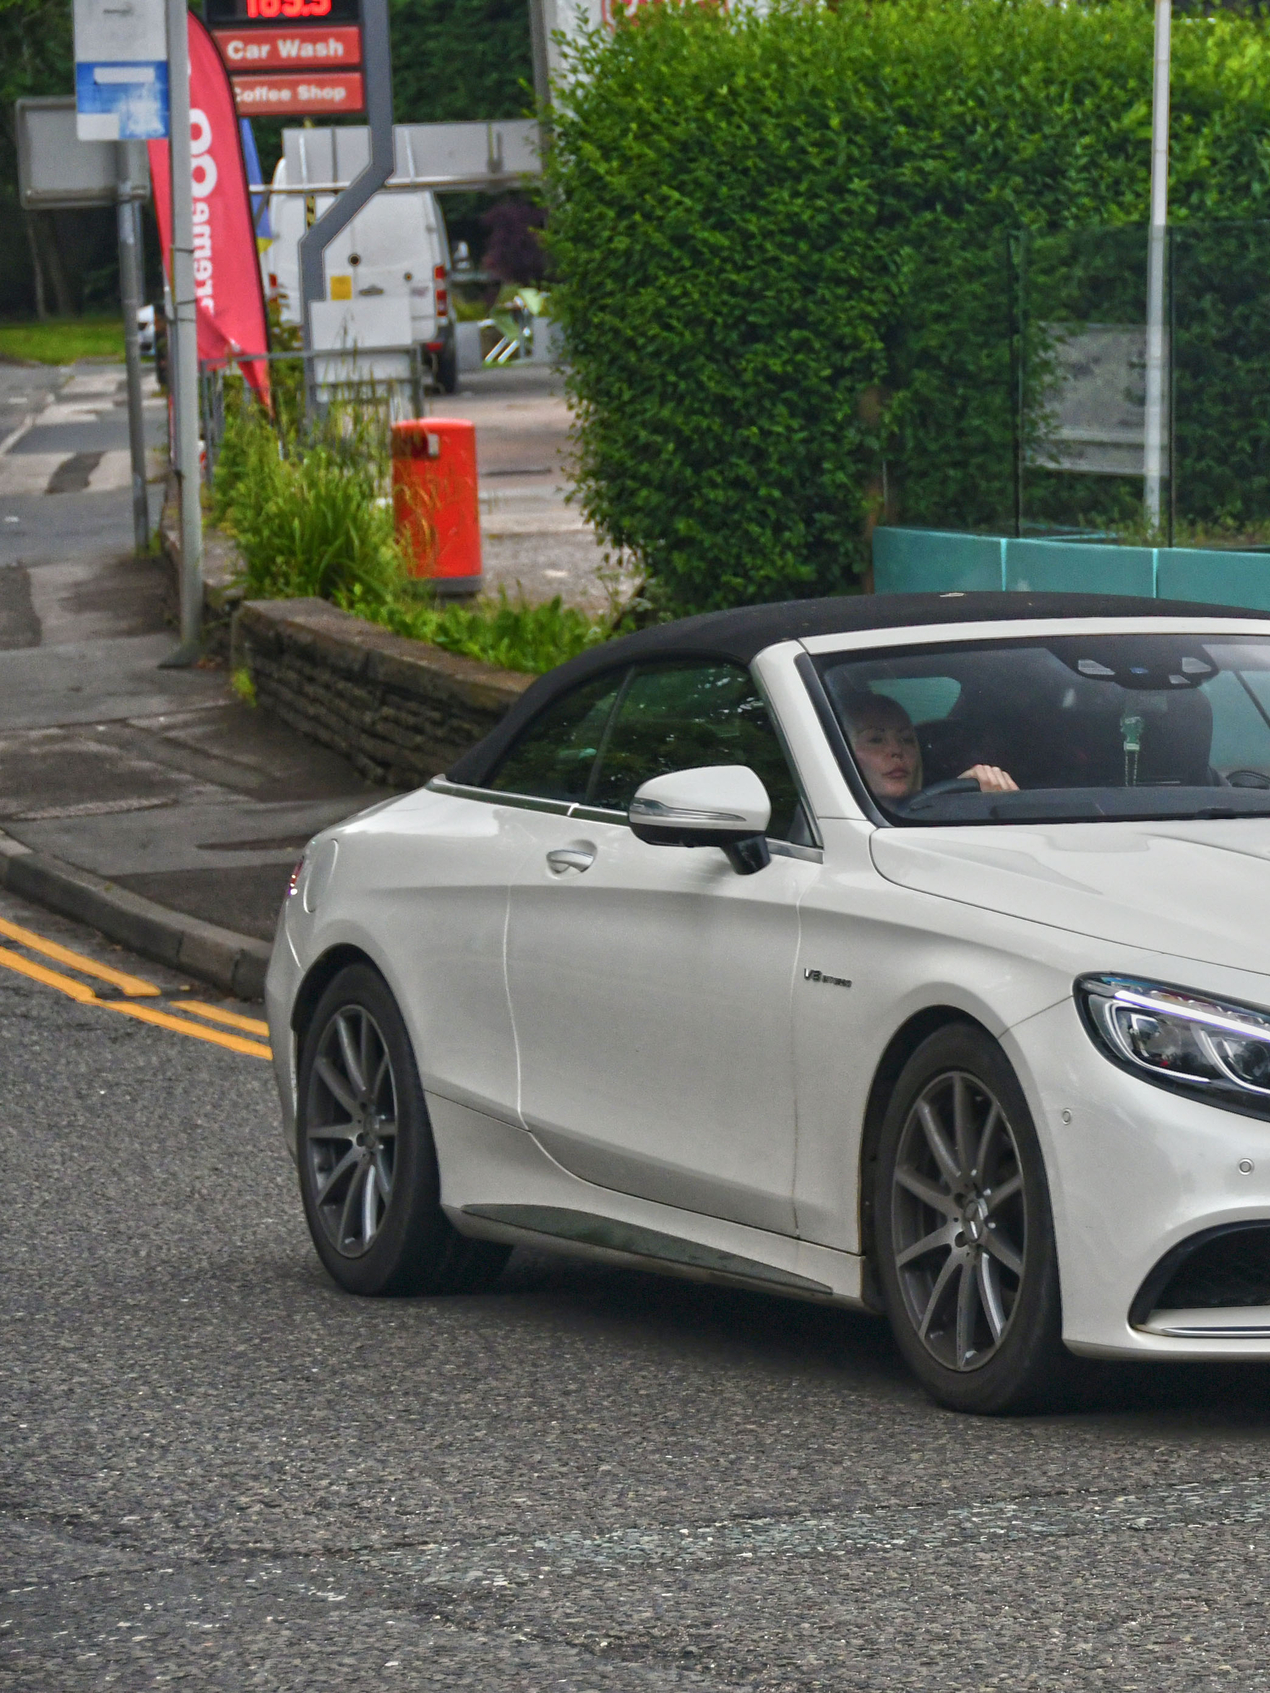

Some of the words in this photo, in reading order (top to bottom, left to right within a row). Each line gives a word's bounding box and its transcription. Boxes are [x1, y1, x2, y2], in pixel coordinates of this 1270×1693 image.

[227, 40, 271, 60] Car
[277, 38, 344, 58] Wash
[298, 84, 346, 103] Shop
